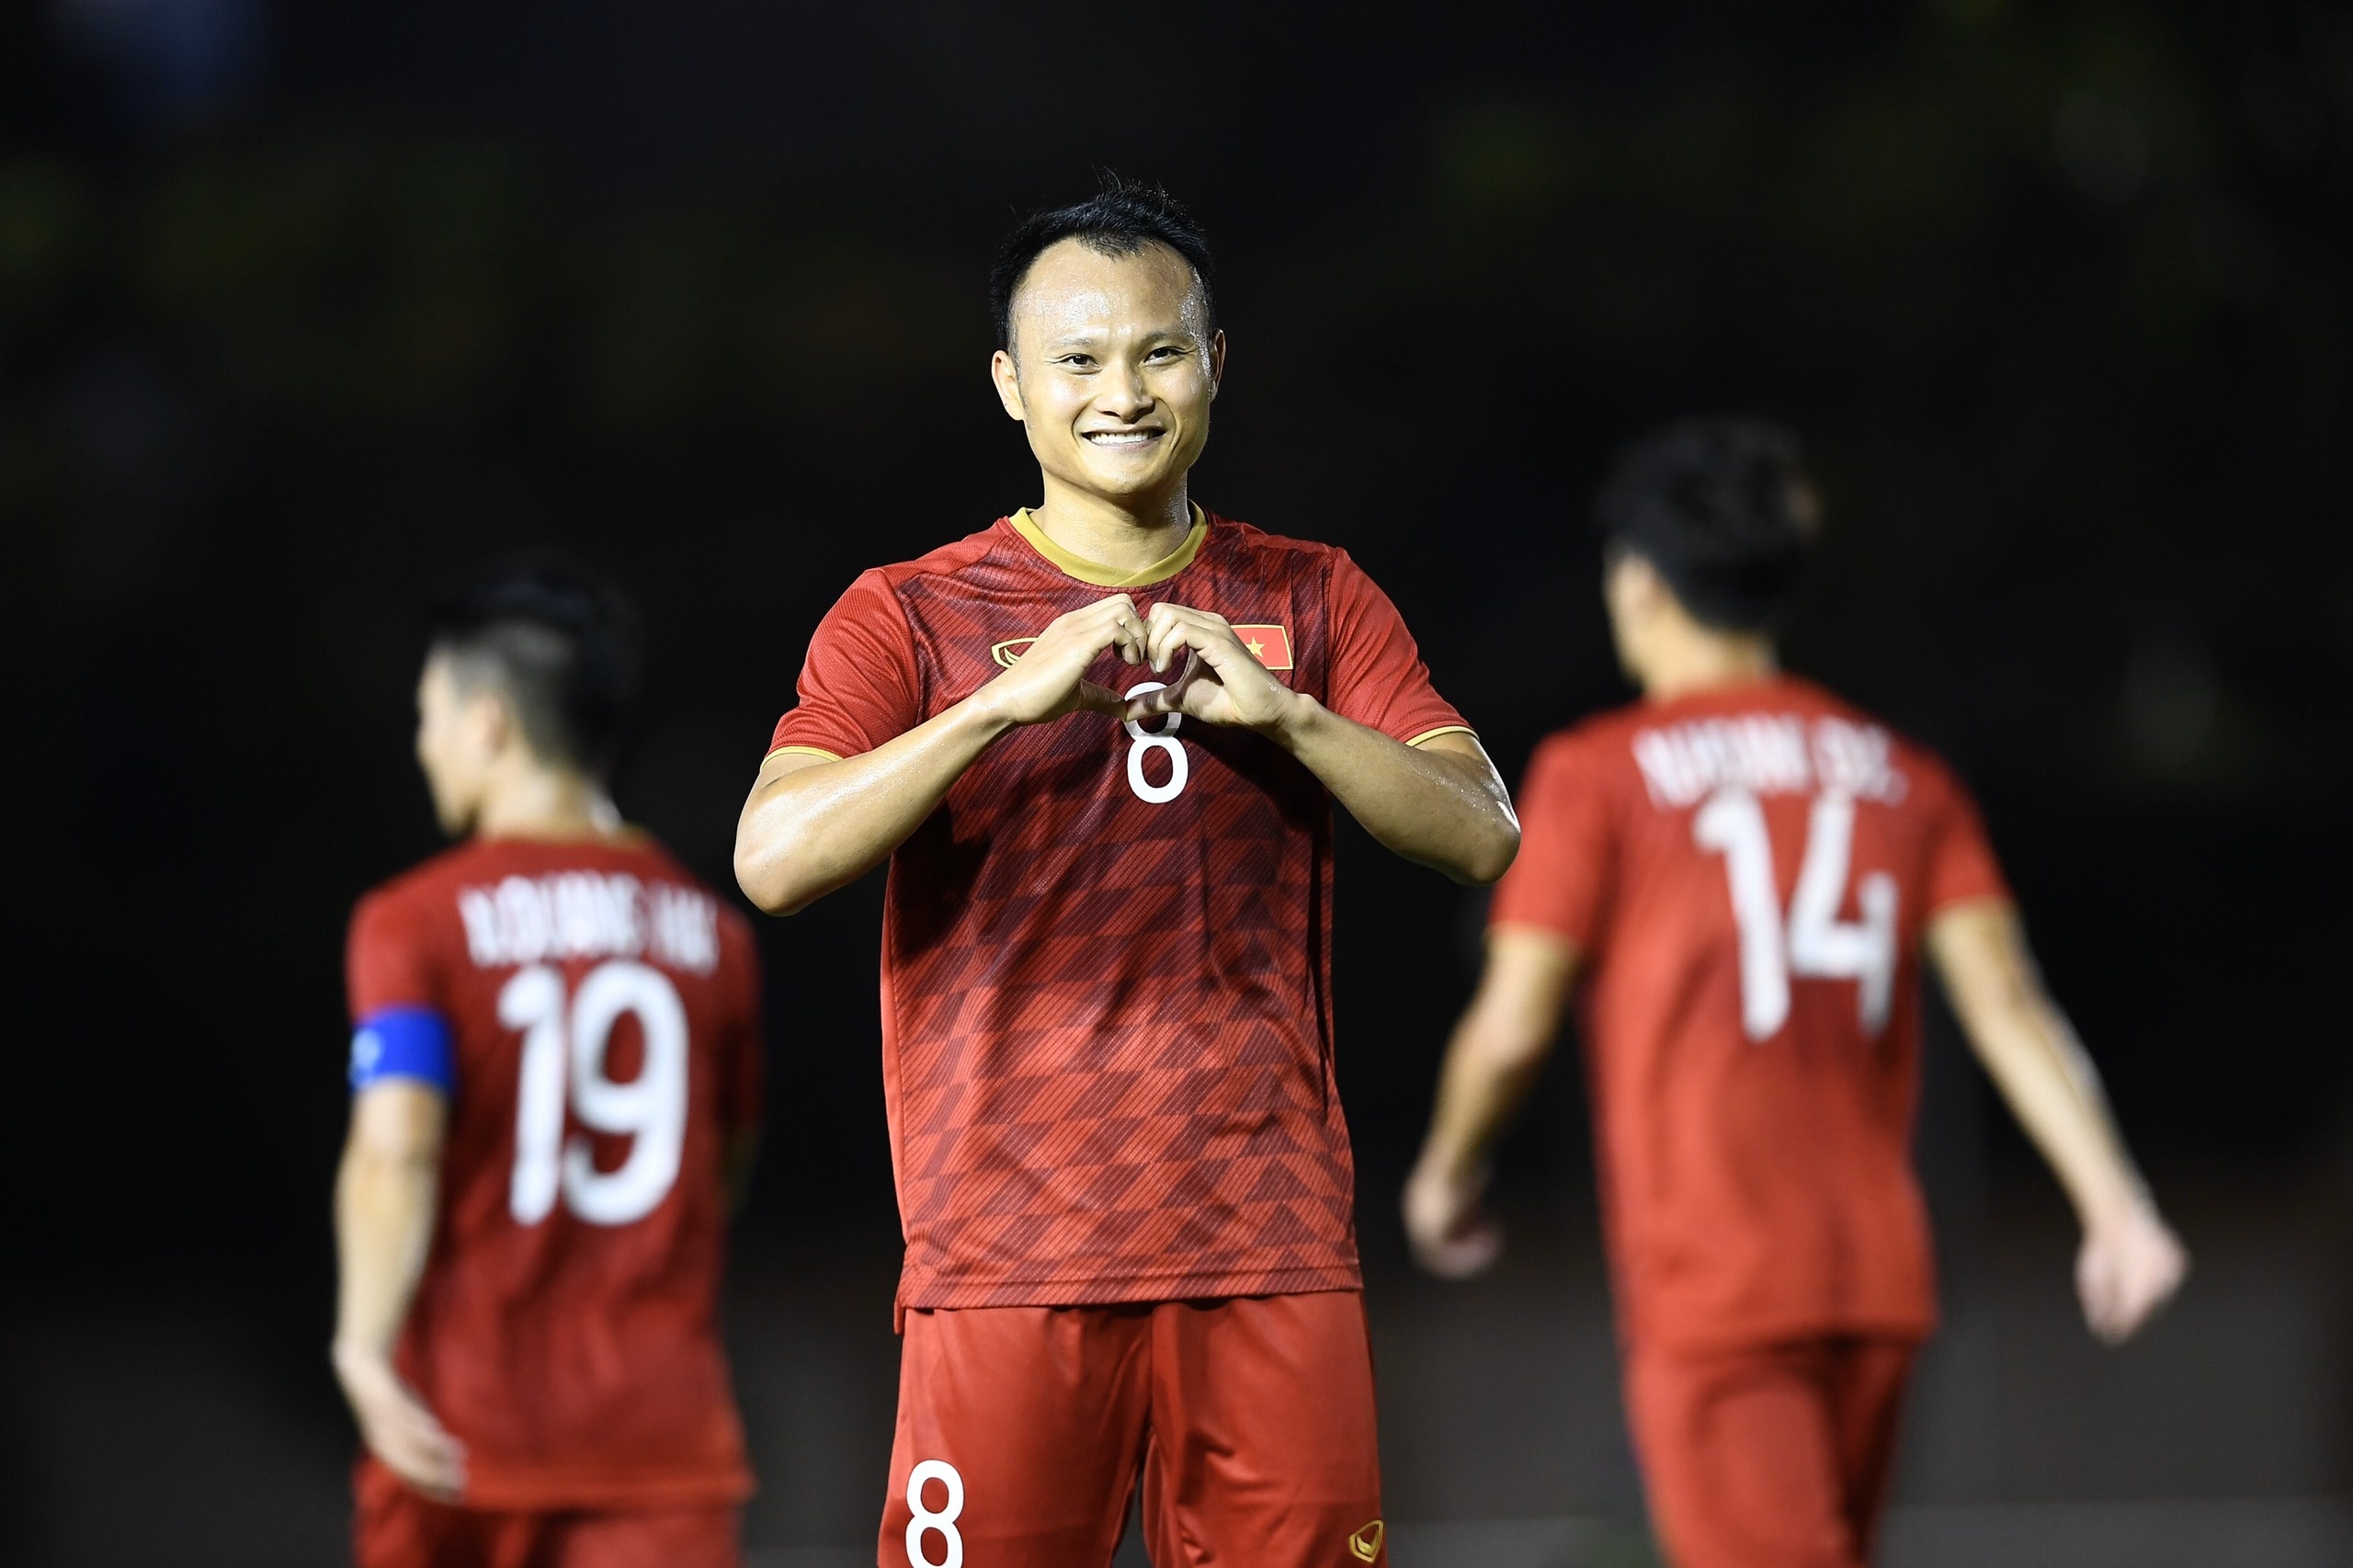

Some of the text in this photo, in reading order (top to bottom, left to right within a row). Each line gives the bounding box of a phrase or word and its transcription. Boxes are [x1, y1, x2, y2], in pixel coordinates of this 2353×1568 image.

[1124, 681, 1188, 804] 8
[1695, 790, 1898, 1040] 14
[499, 962, 688, 1225] 19
[905, 1460, 964, 1568] 8
